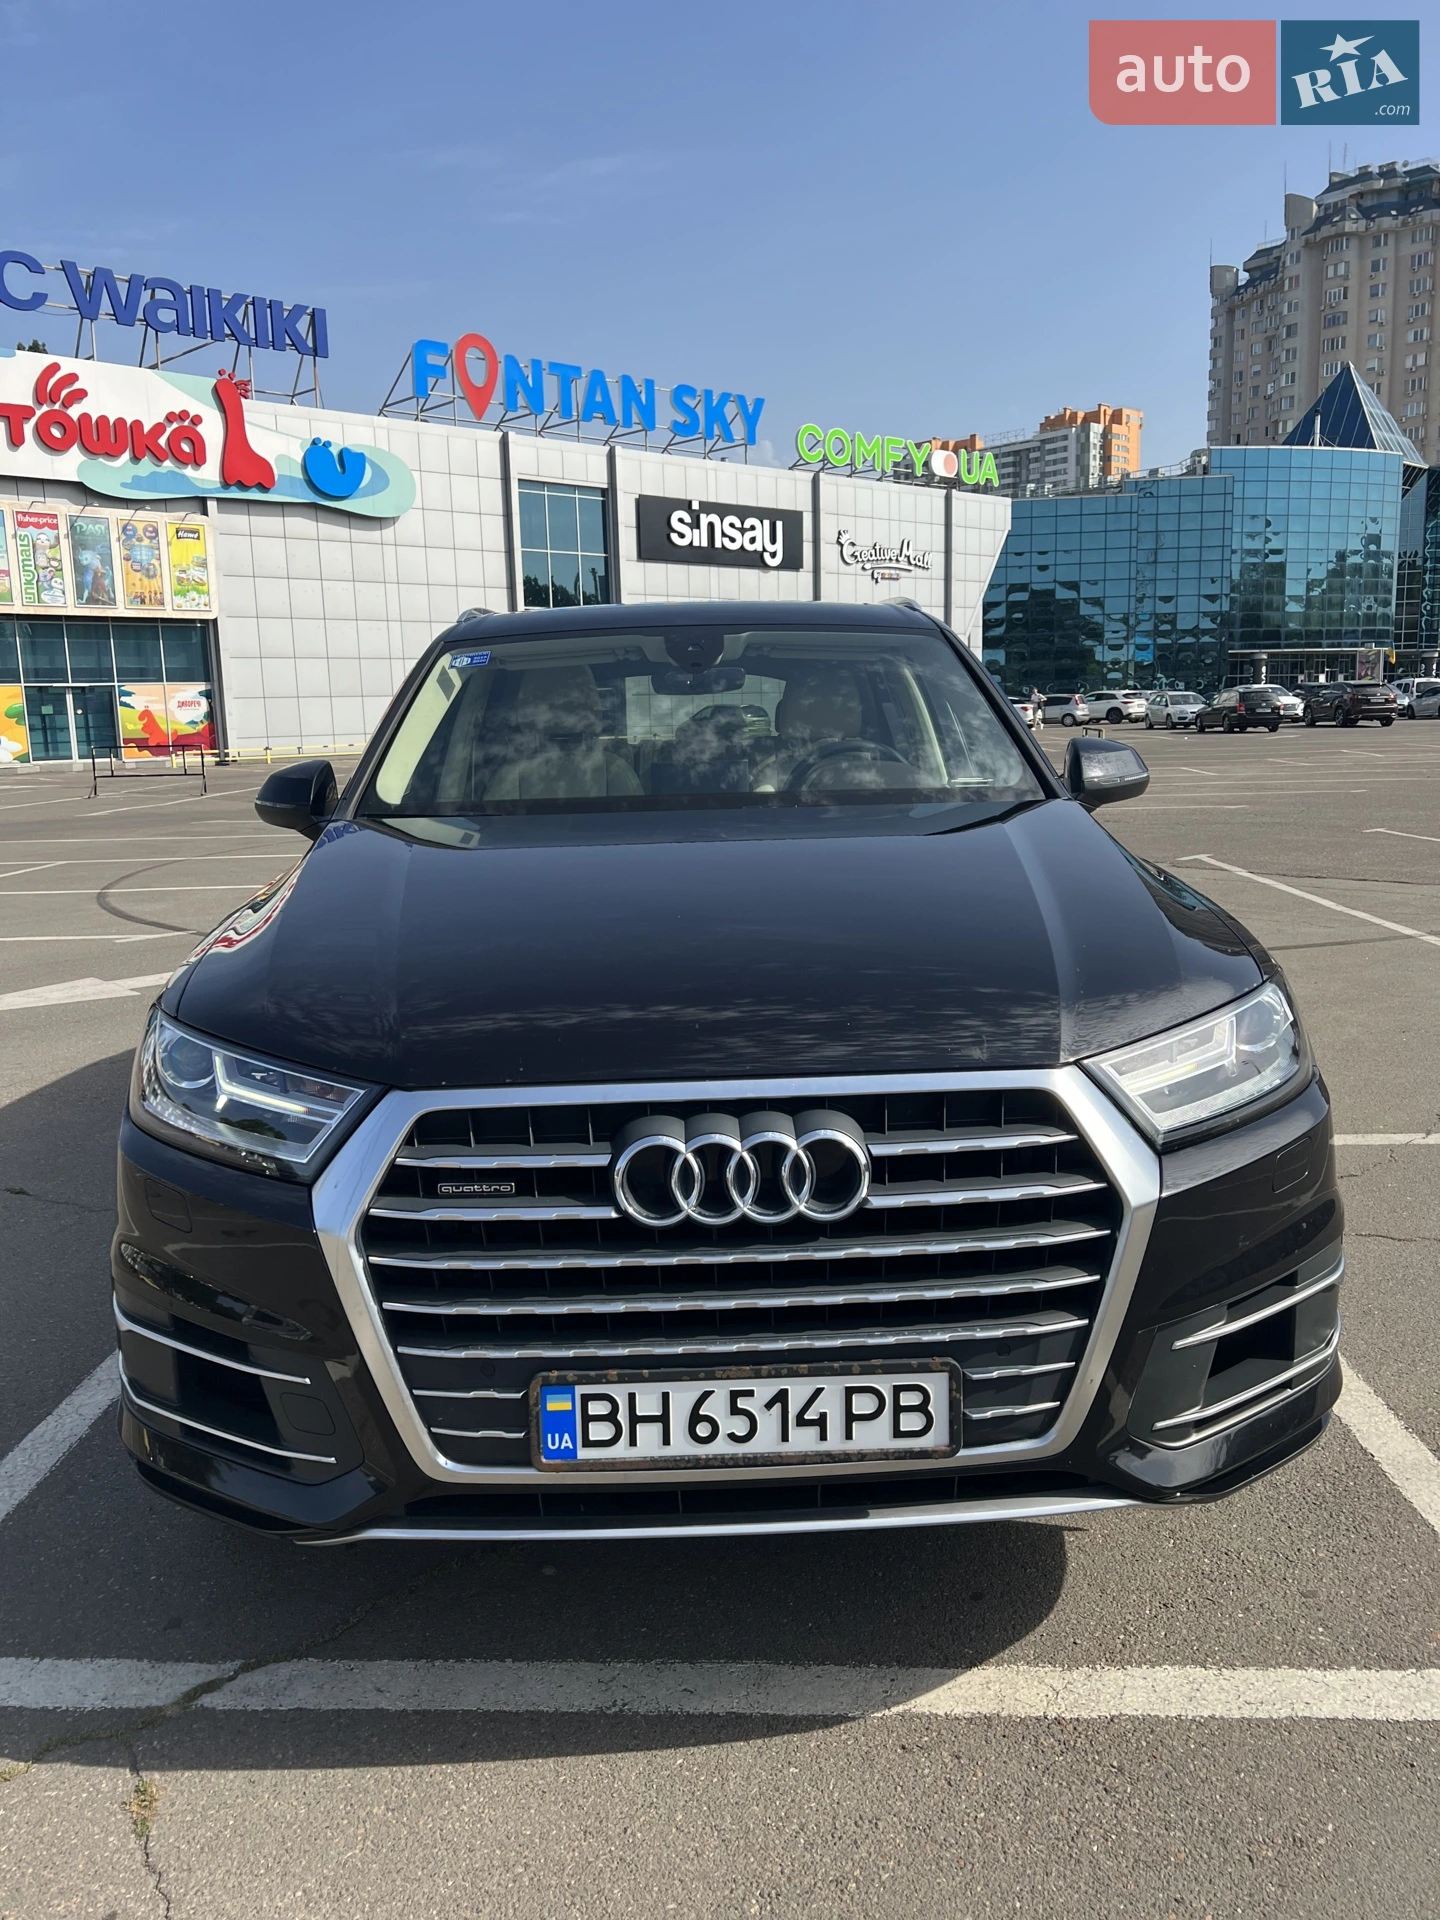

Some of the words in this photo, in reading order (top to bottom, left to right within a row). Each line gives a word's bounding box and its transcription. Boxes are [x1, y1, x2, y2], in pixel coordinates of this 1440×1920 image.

[412, 333, 656, 431] FONTAN
[669, 384, 765, 446] SKY
[797, 423, 931, 477] COMFY
[17, 513, 58, 525] fisher-price
[669, 500, 784, 567] sinsay
[842, 539, 897, 564] Creative
[898, 538, 933, 569] Mall
[441, 1185, 511, 1193] quattro
[547, 1432, 574, 1450] UA
[580, 1391, 672, 1448] BH
[687, 1387, 829, 1445] 6514
[844, 1383, 935, 1442] PB
